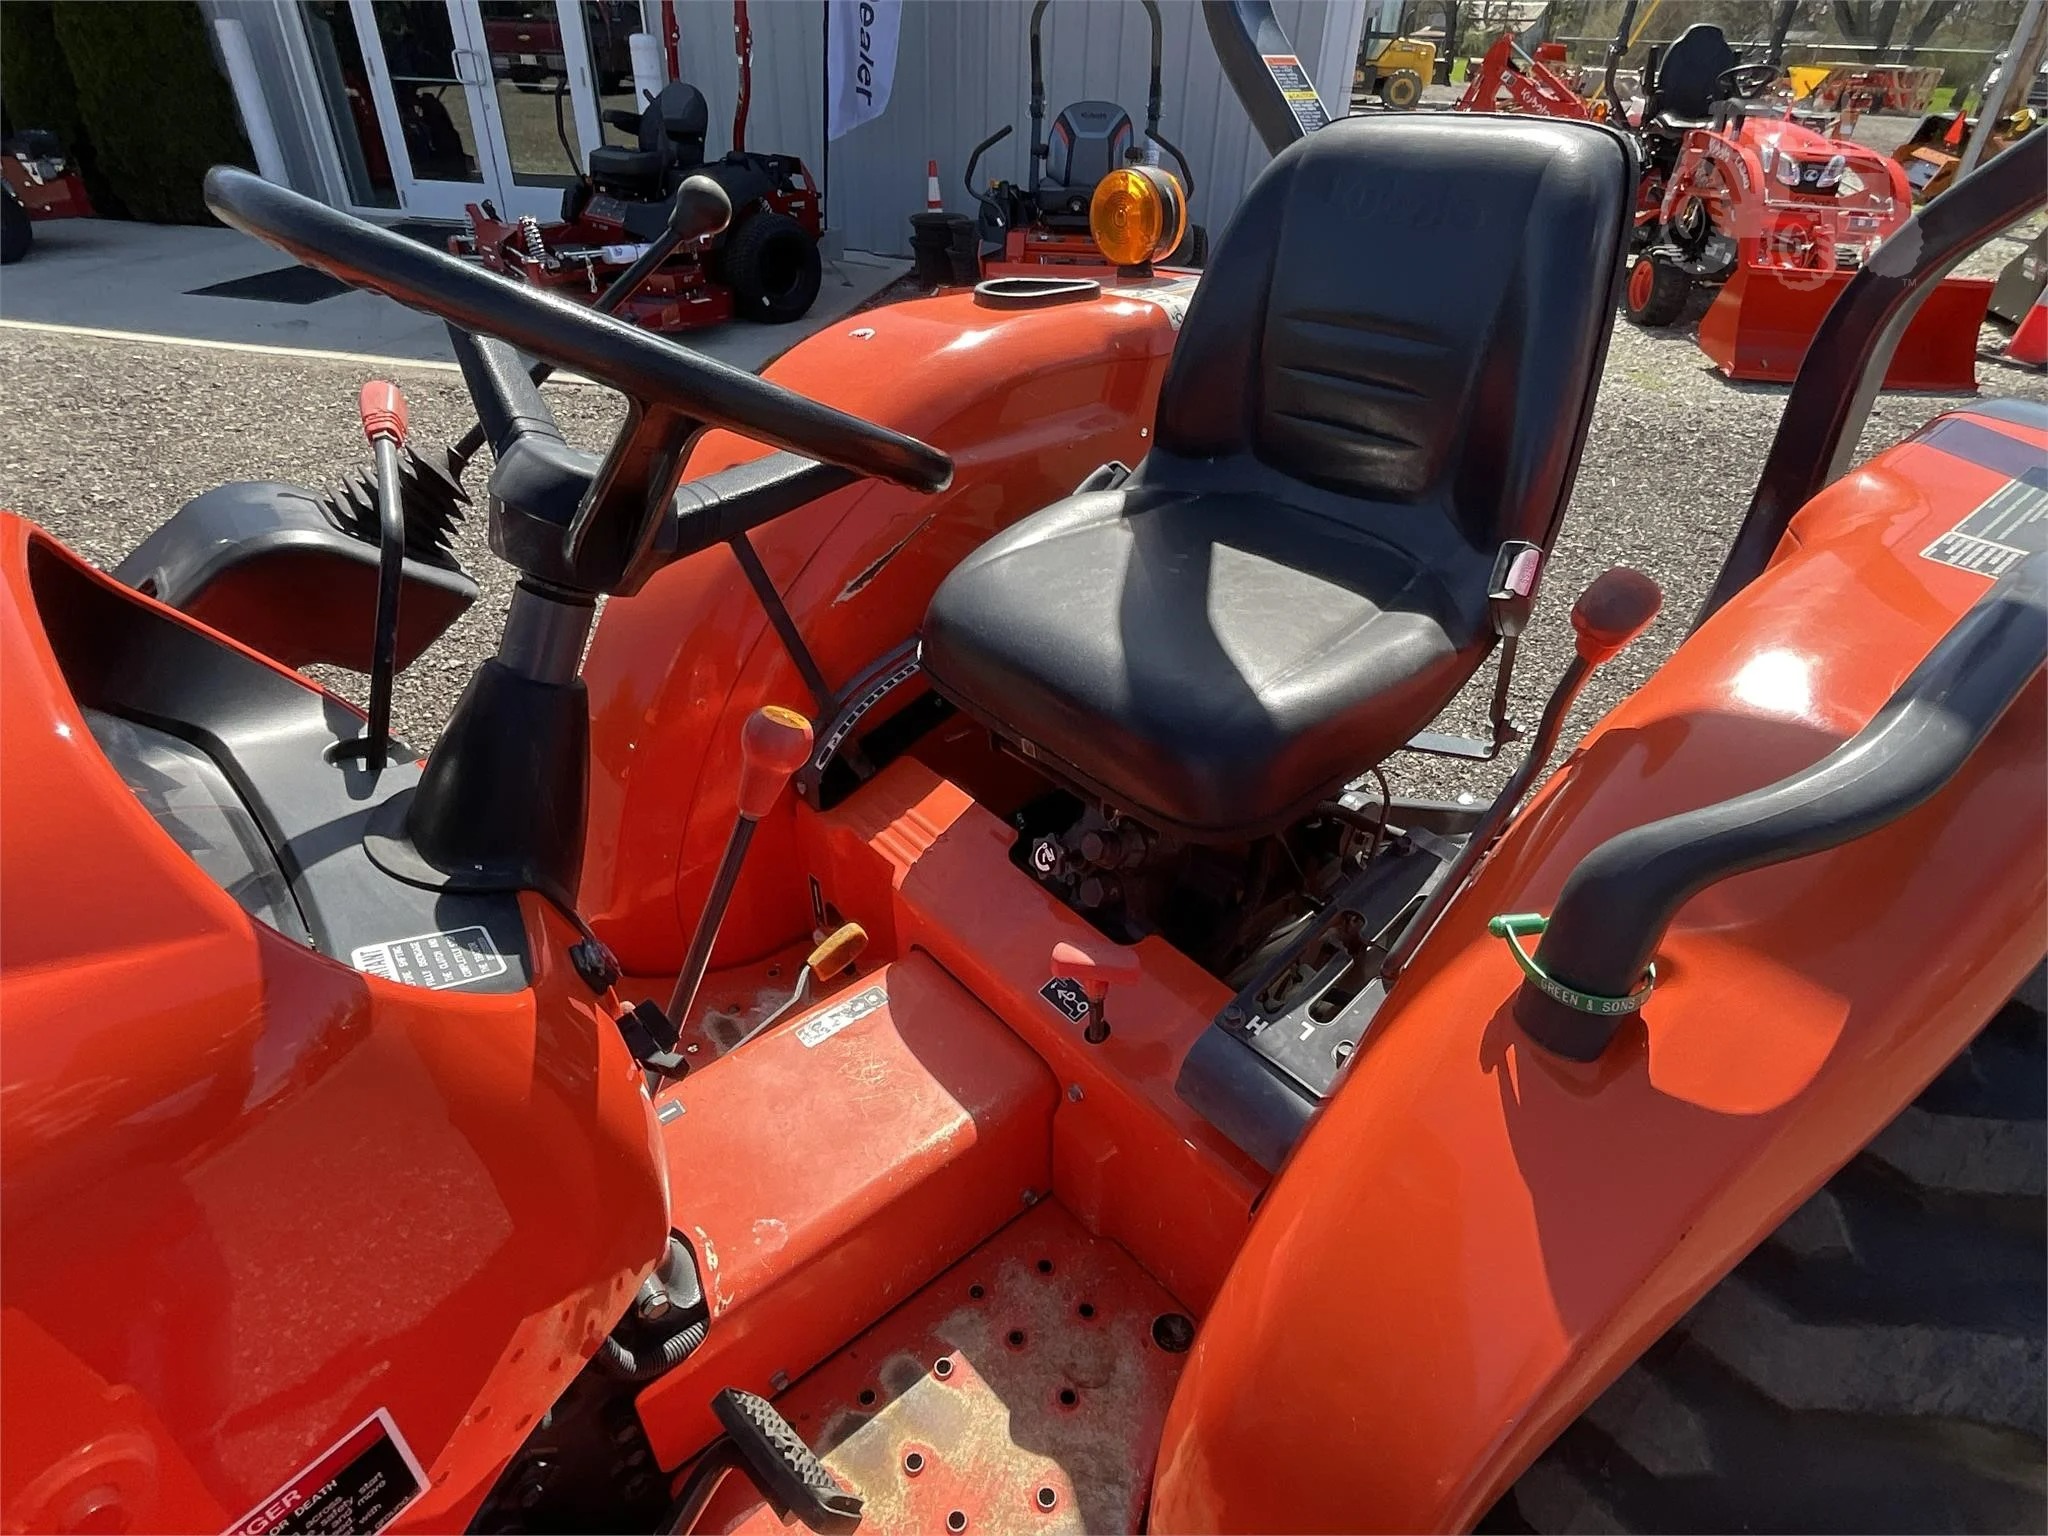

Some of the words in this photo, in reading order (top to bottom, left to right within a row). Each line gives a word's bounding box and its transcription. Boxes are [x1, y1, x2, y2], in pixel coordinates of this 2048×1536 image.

[856, 0, 875, 106] ealer
[1540, 978, 1579, 1006] GREEN
[1602, 998, 1636, 1013] SONS
[1245, 1015, 1269, 1036] H
[1299, 1021, 1315, 1041] L
[357, 1480, 387, 1506] move
[358, 1471, 384, 1495] start
[238, 1490, 302, 1536] GER
[269, 1519, 290, 1536] OR
[294, 1479, 338, 1518] DEATH
[305, 1496, 343, 1529] across
[359, 1503, 382, 1524] with
